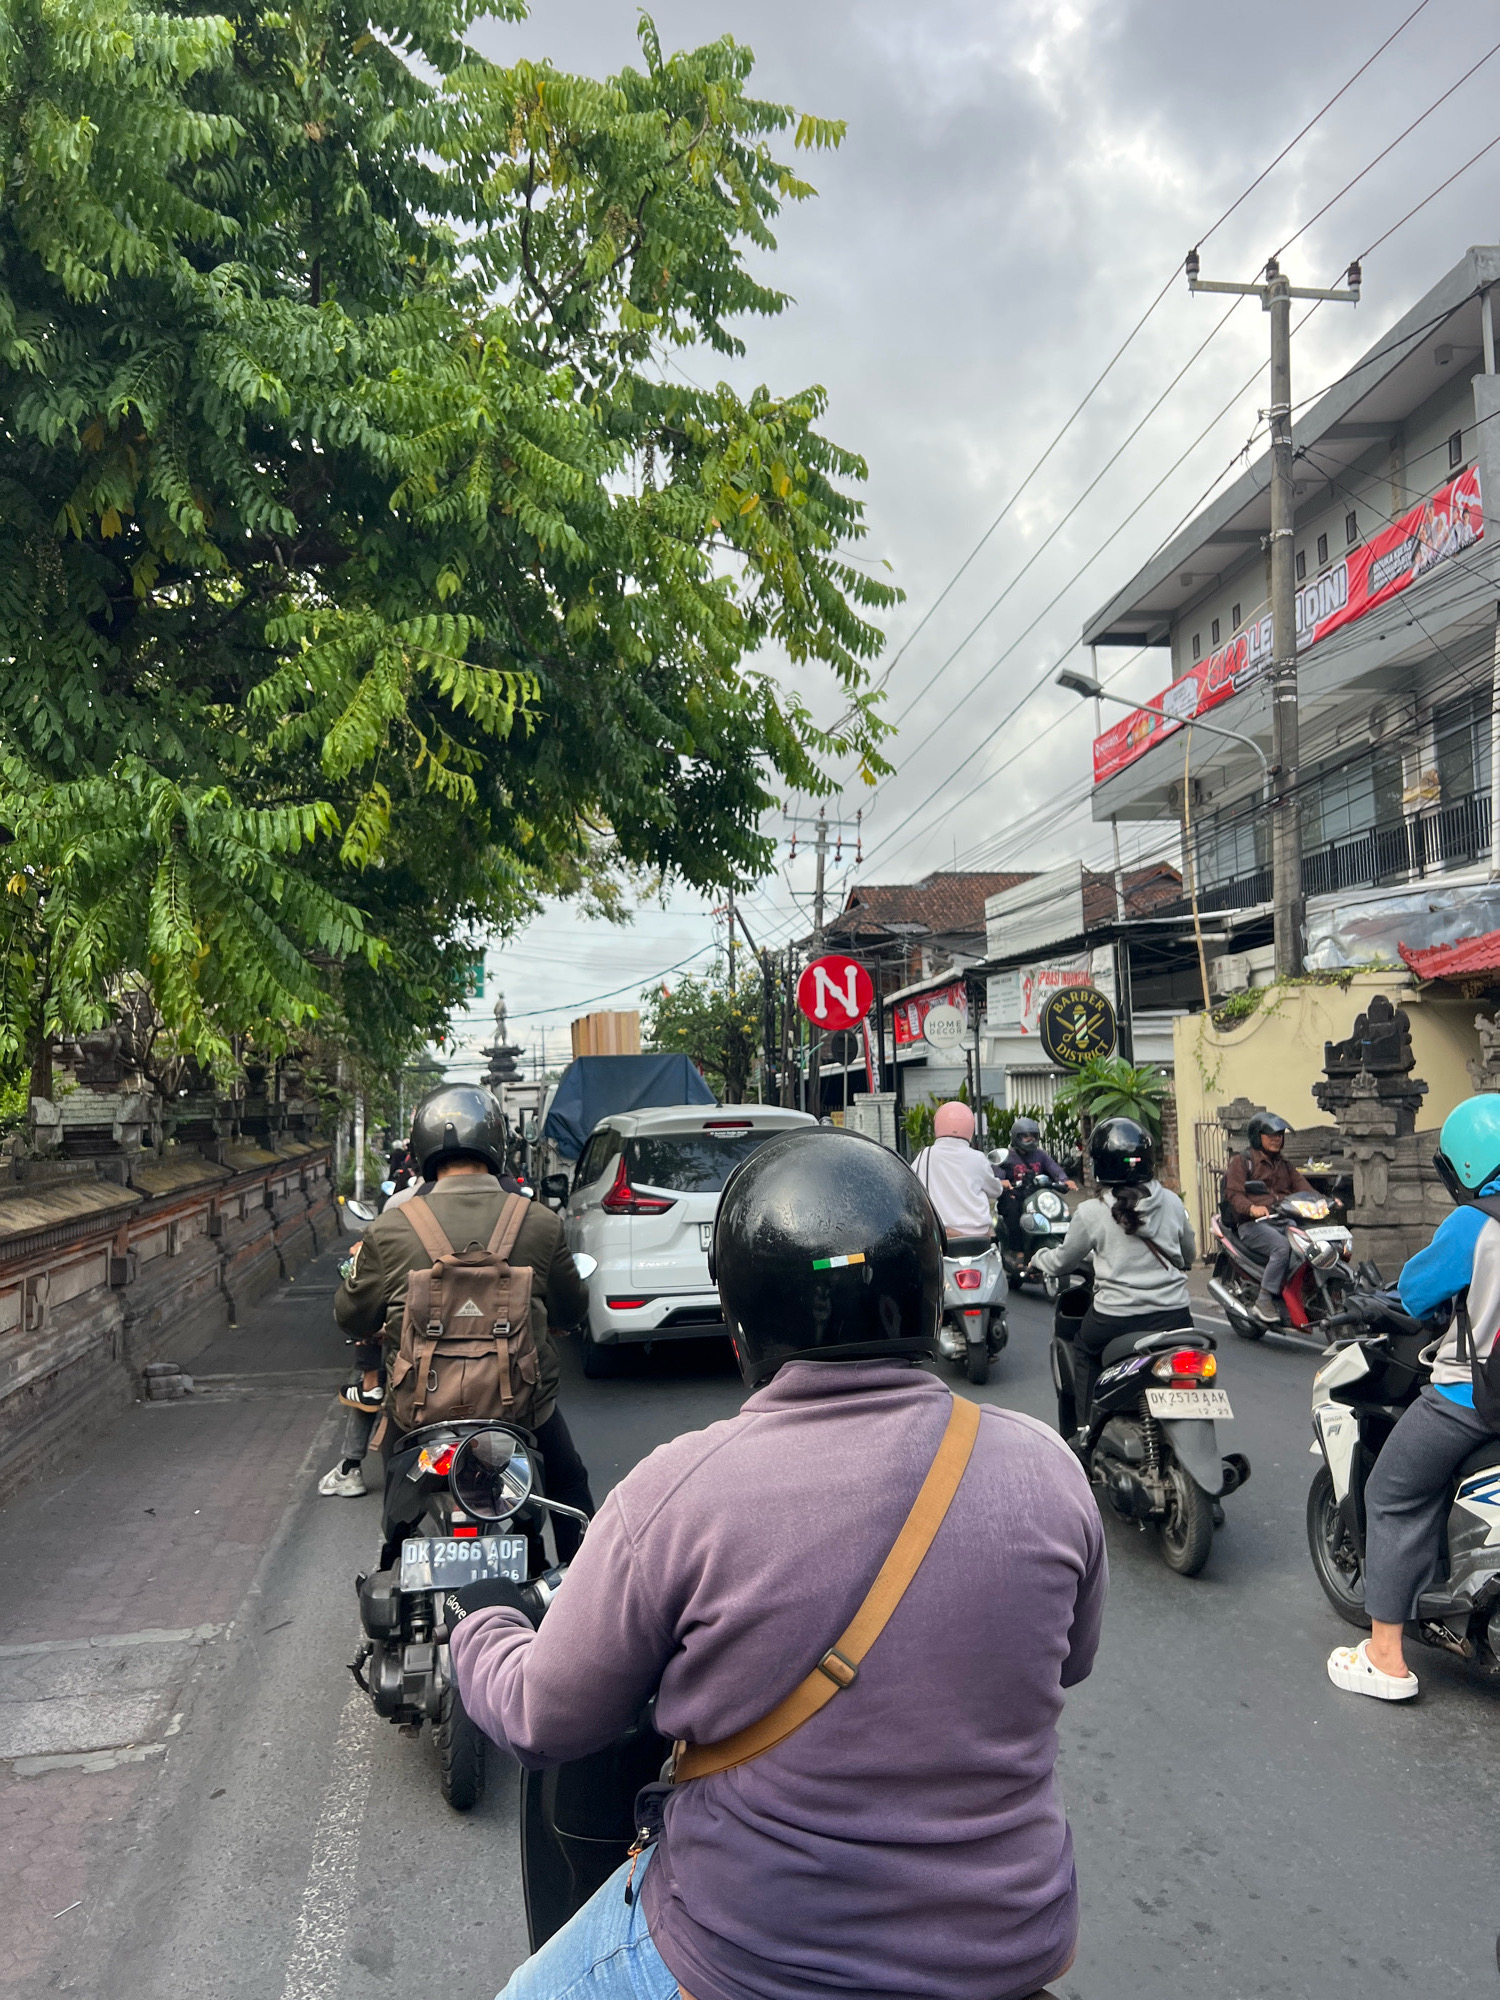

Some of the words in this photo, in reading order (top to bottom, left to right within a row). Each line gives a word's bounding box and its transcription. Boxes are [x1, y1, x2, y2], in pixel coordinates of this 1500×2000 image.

[1209, 634, 1248, 690] SIAP
[1305, 564, 1347, 629] DINI
[812, 964, 859, 1020] N
[1052, 990, 1105, 1014] BARBER
[929, 1020, 962, 1029] HOME
[929, 1027, 962, 1035] DECOR
[1056, 1040, 1109, 1063] DISTRICT
[1150, 1392, 1168, 1404] DK
[1169, 1392, 1199, 1404] 2573
[1202, 1392, 1227, 1404] AAK
[405, 1542, 431, 1564] DK
[433, 1541, 482, 1563] 2966
